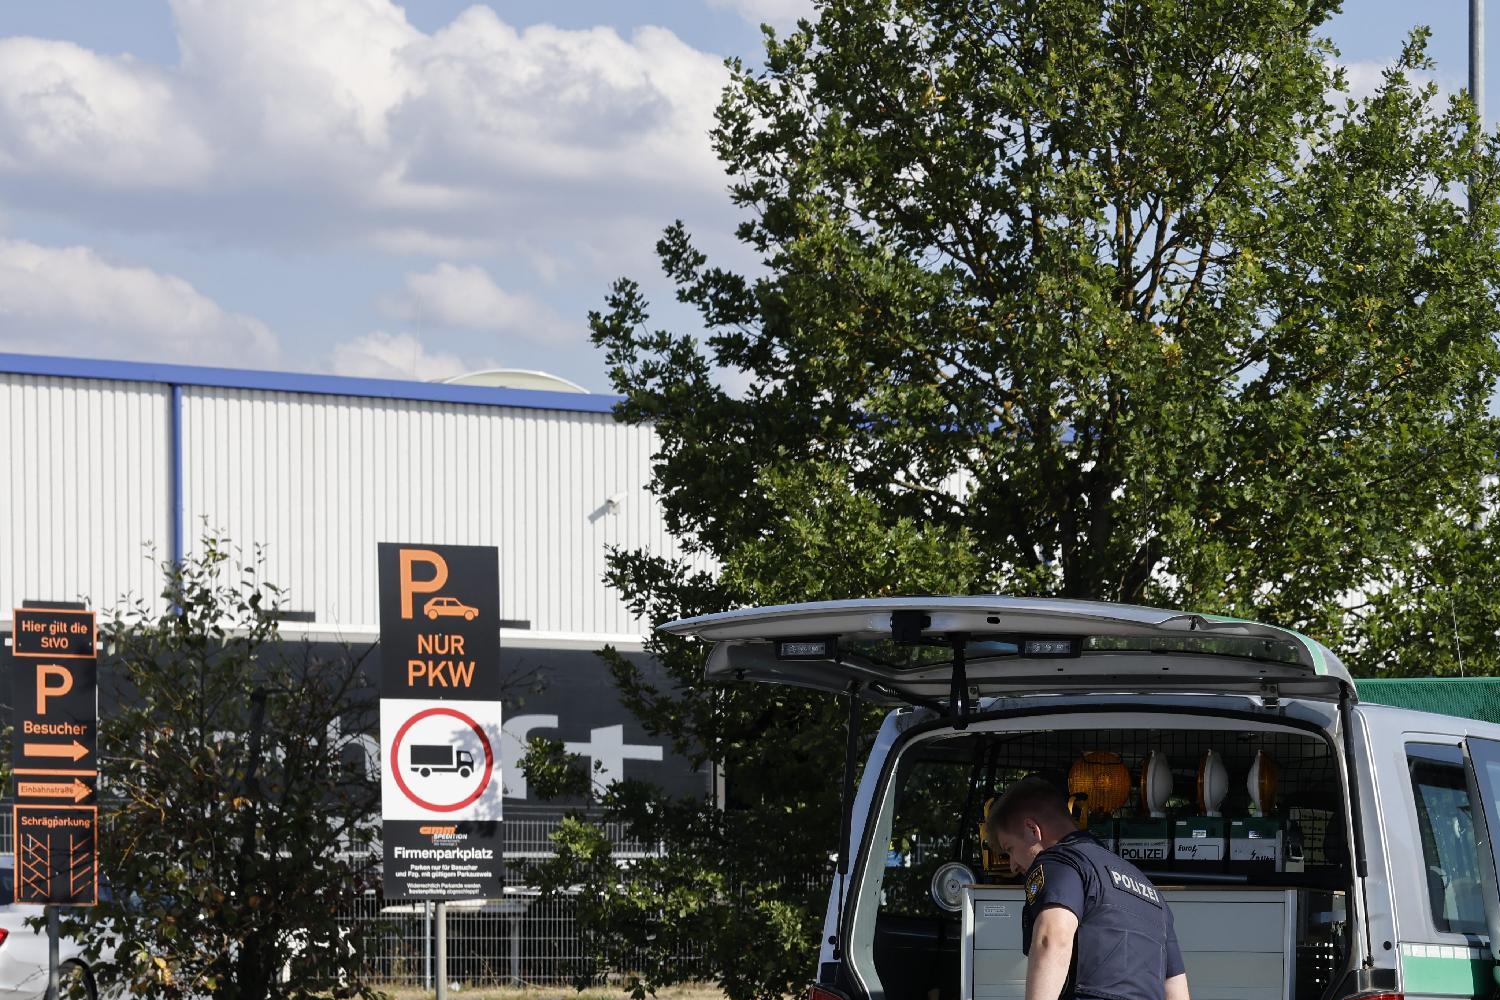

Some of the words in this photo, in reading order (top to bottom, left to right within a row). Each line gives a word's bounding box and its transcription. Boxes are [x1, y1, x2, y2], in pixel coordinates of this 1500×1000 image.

[400, 548, 449, 620] P
[21, 620, 47, 632] Hier
[49, 620, 67, 636] gilt
[70, 622, 88, 634] die
[40, 636, 69, 649] StVO
[417, 633, 465, 655] NUR
[407, 659, 476, 688] PKW
[36, 664, 74, 715] P
[23, 720, 87, 735] Besucher
[21, 785, 74, 795] Einbahnstraße
[21, 816, 91, 829] Schrägparkung
[393, 846, 494, 861] Firmenparkplatz
[1121, 848, 1164, 859] POLIZEI
[1110, 870, 1160, 903] POLIZEI
